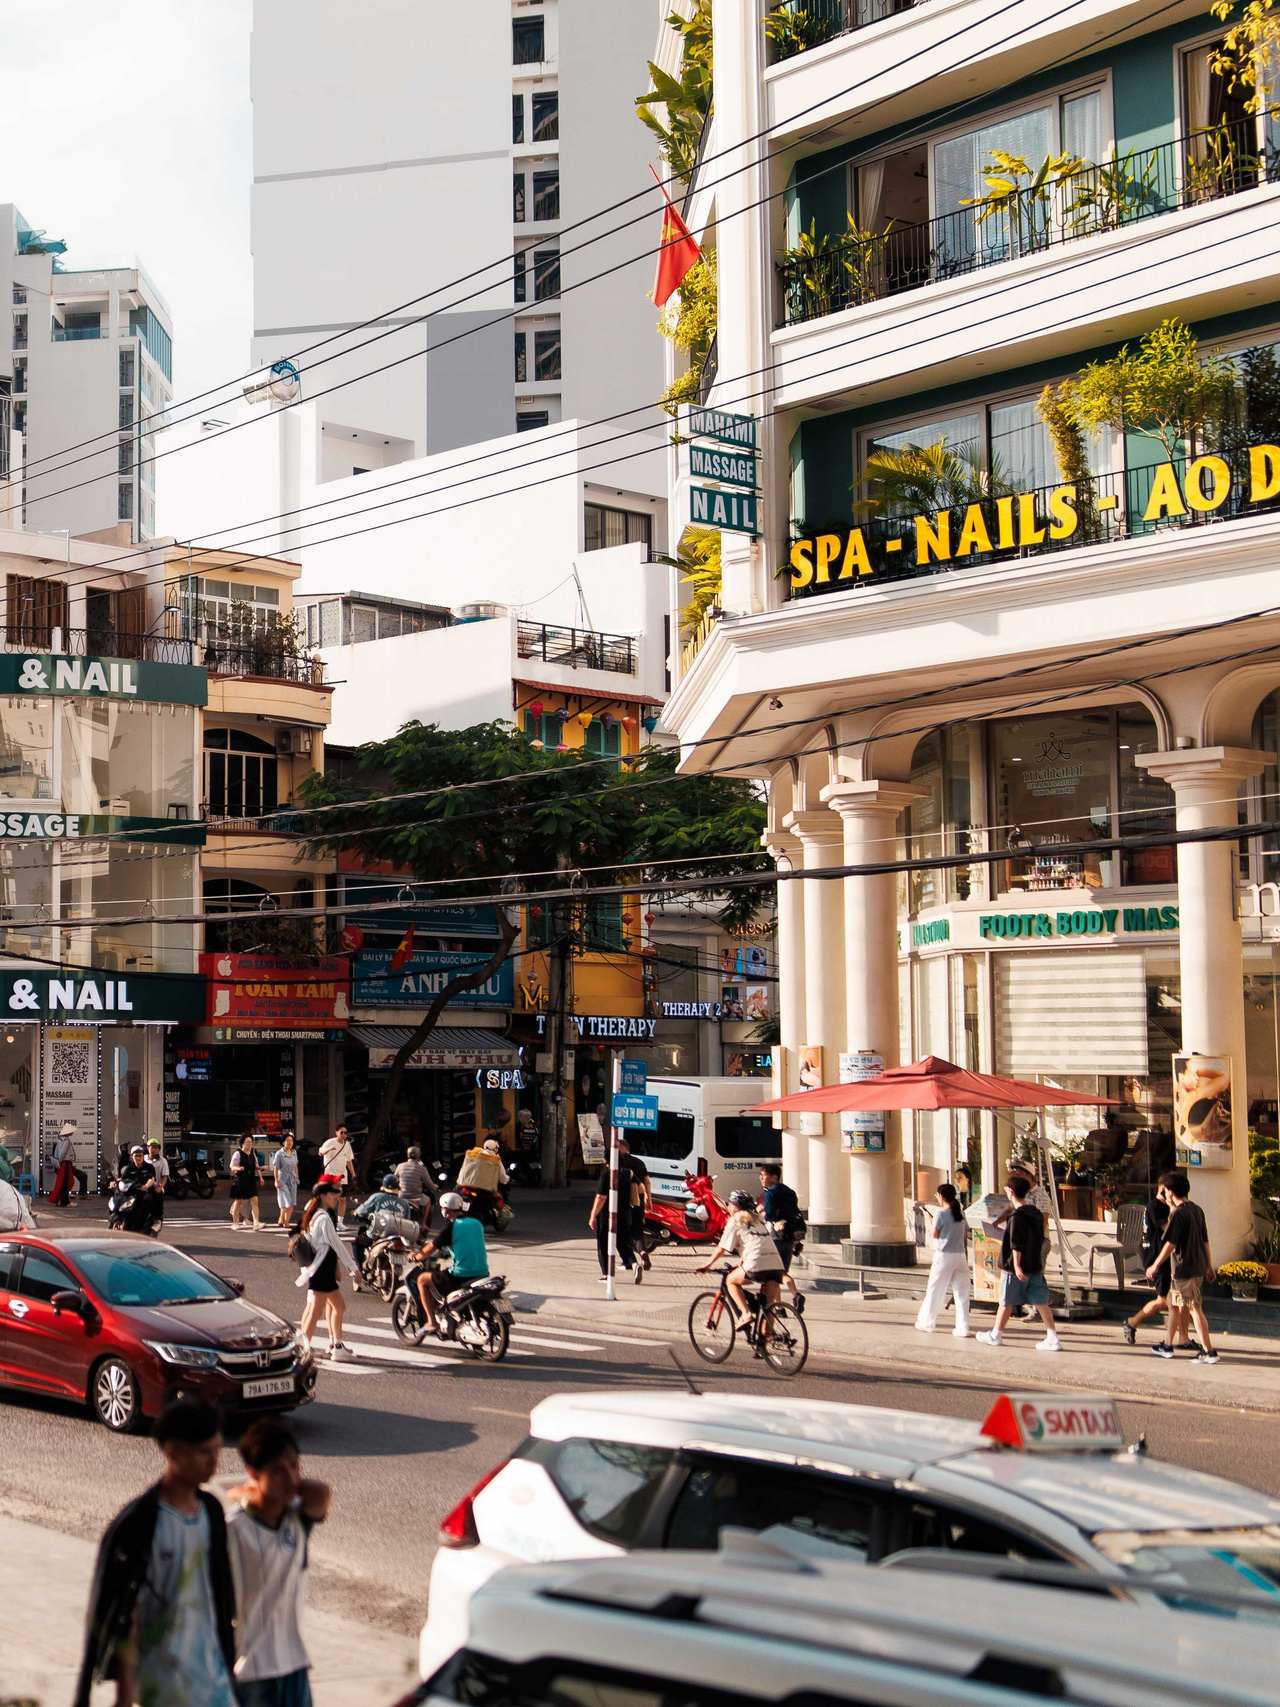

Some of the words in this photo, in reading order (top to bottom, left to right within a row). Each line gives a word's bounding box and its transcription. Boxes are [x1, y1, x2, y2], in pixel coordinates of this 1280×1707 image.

[691, 408, 753, 443] MAHAMI
[691, 450, 754, 483] MASSAGE
[693, 490, 754, 528] NAIL
[790, 528, 873, 588] SPA
[914, 485, 1078, 566] NAILS
[1142, 455, 1231, 521] AO
[19, 659, 50, 689] &
[56, 660, 137, 694] NAIL
[1056, 908, 1119, 934] BODY
[426, 955, 439, 963] BAY
[8, 979, 40, 1010] &
[48, 980, 133, 1010] NAIL
[663, 1002, 711, 1016] THERAPY
[715, 1003, 721, 1016] 2
[237, 1030, 257, 1039] CHUYÊN
[261, 1030, 274, 1041] ĐIỆN
[275, 1031, 291, 1041] THOẠI
[291, 1031, 325, 1039] SMARTPHONE
[589, 1017, 657, 1037] THERAPY
[455, 1054, 515, 1065] THU
[486, 1069, 526, 1090] SPA
[45, 1091, 73, 1099] MASSAGE
[165, 1092, 180, 1103] SMART
[165, 1111, 180, 1123] PHONE
